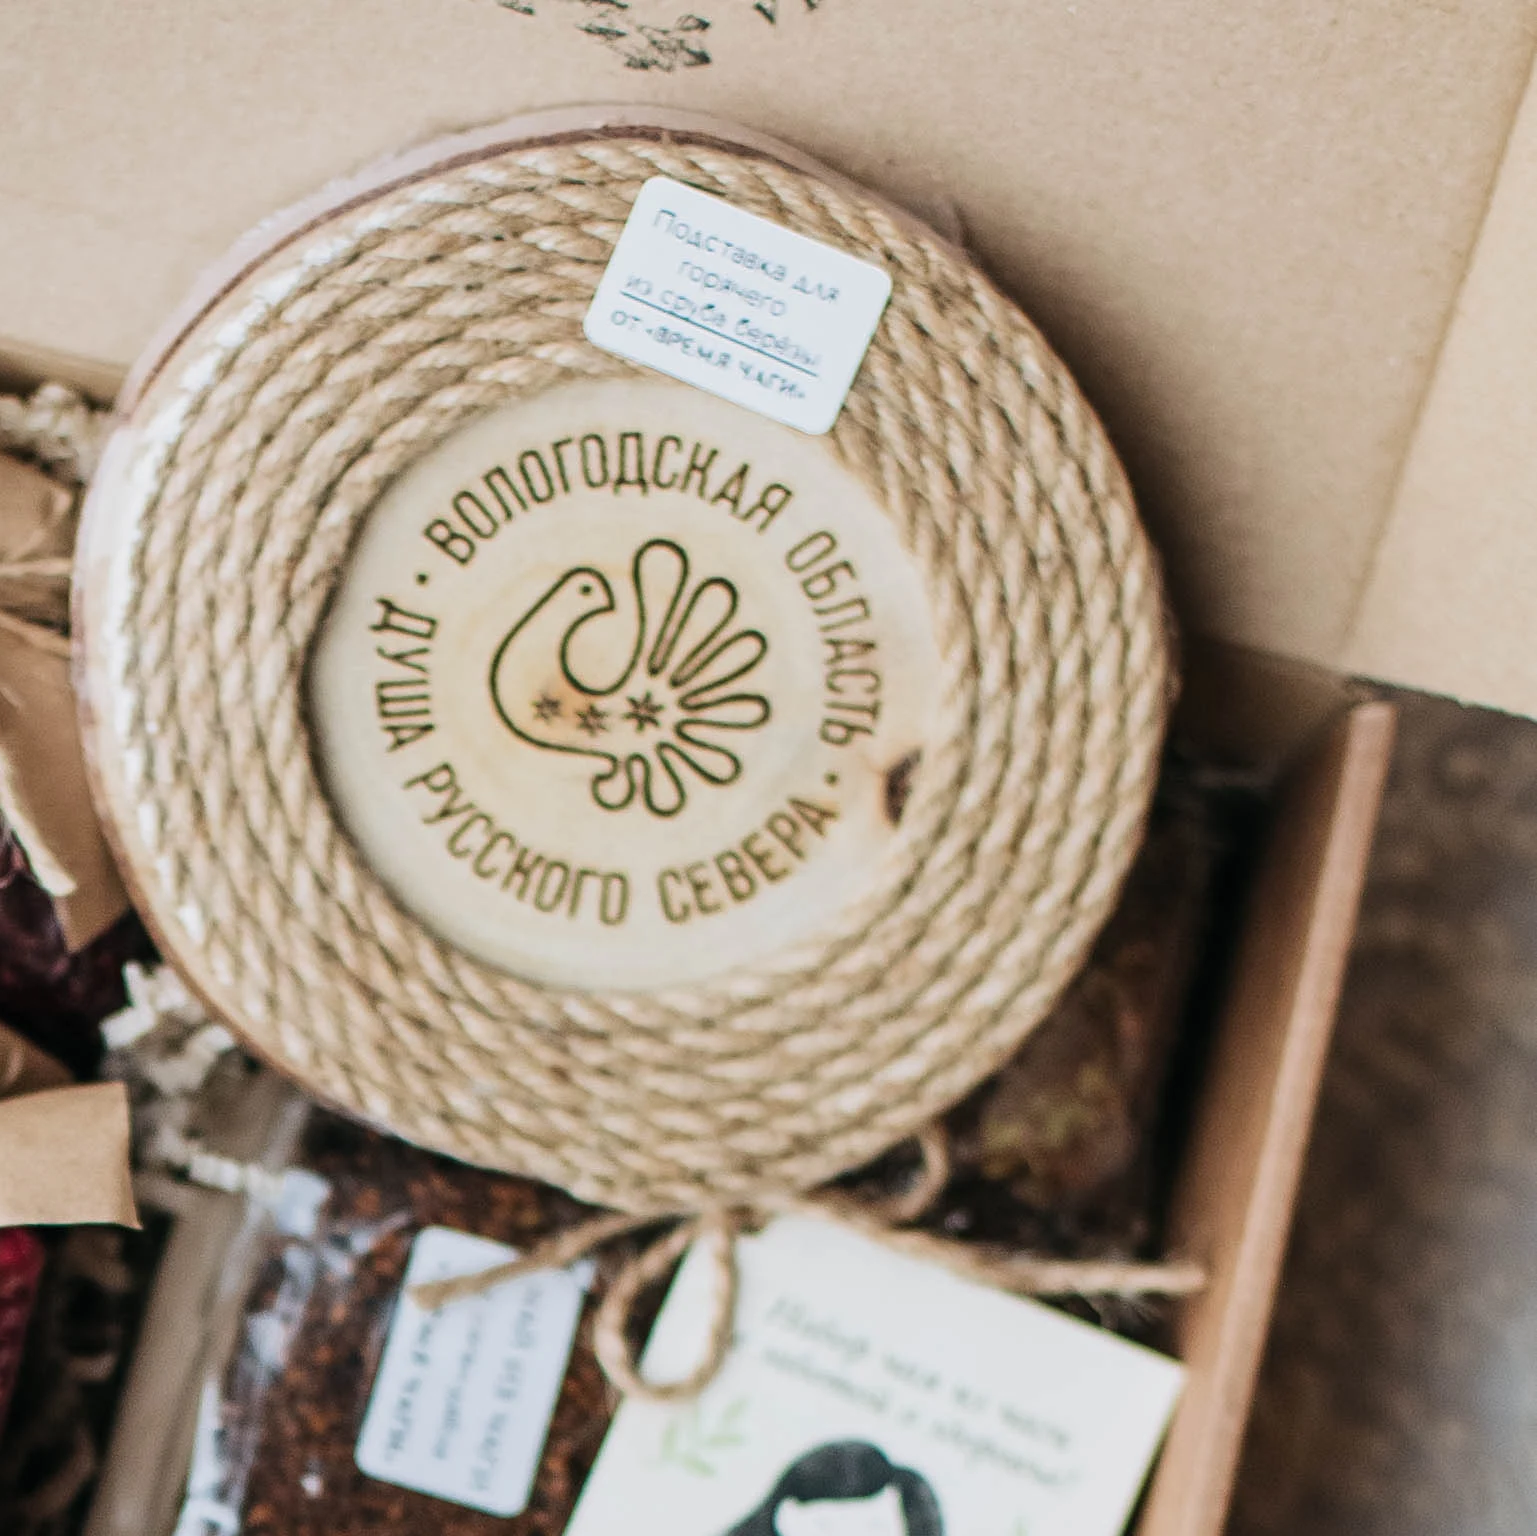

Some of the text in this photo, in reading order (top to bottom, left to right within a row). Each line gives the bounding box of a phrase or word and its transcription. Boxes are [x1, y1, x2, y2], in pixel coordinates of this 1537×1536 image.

[651, 208, 840, 304] Подставка для
[677, 259, 787, 317] горячего
[423, 432, 884, 748] ВОЛОГОДСКАЯ ОБЛАСТЬ
[369, 597, 841, 927] ДУША РУССКОГО СЕВЕРА
